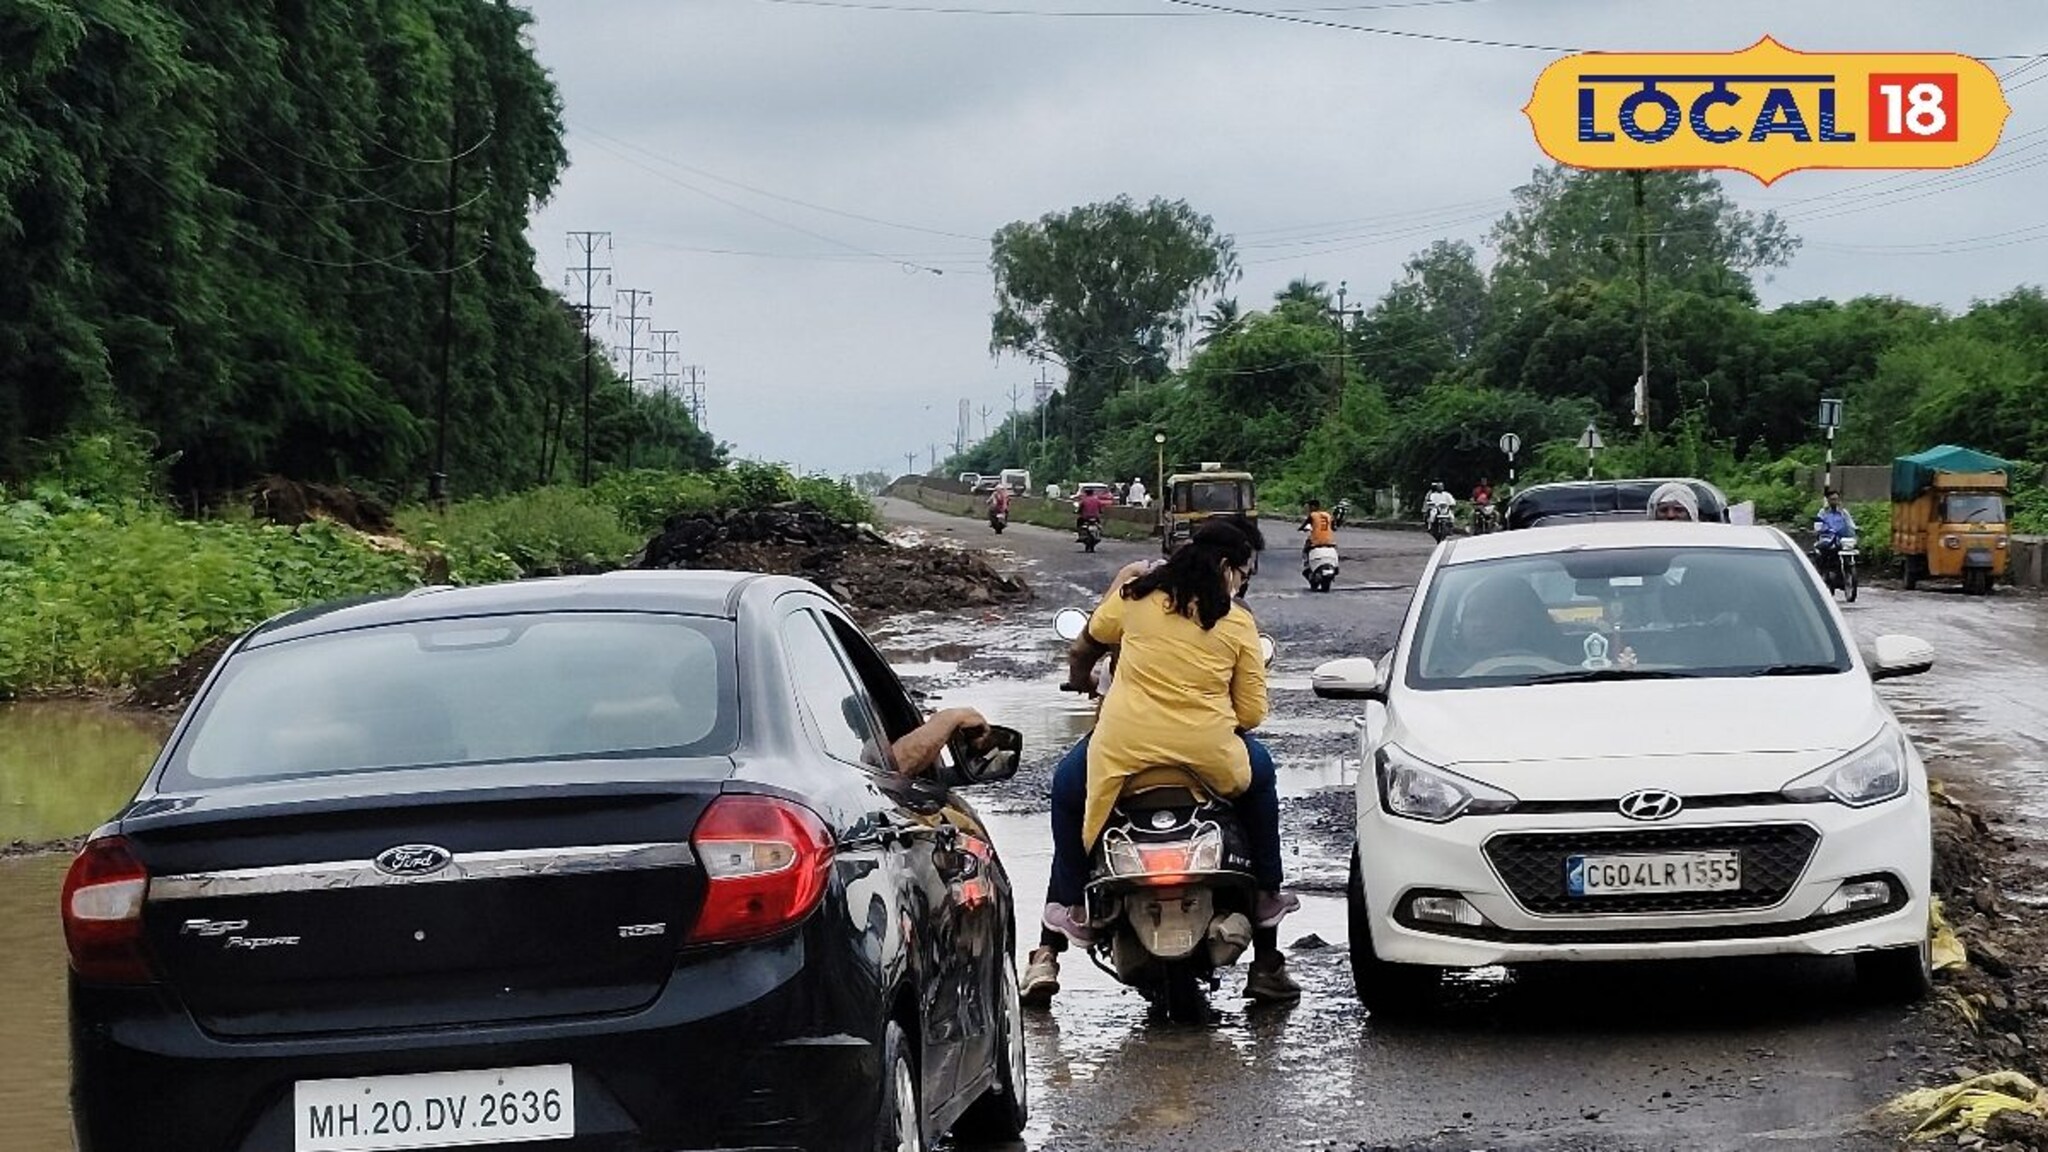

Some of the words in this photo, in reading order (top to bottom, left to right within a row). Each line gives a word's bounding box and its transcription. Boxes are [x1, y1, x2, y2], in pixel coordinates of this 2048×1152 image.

[391, 848, 433, 871] Ford
[1588, 859, 1738, 888] CG04LR1555
[309, 1088, 562, 1139] MH.20.DV.2636
